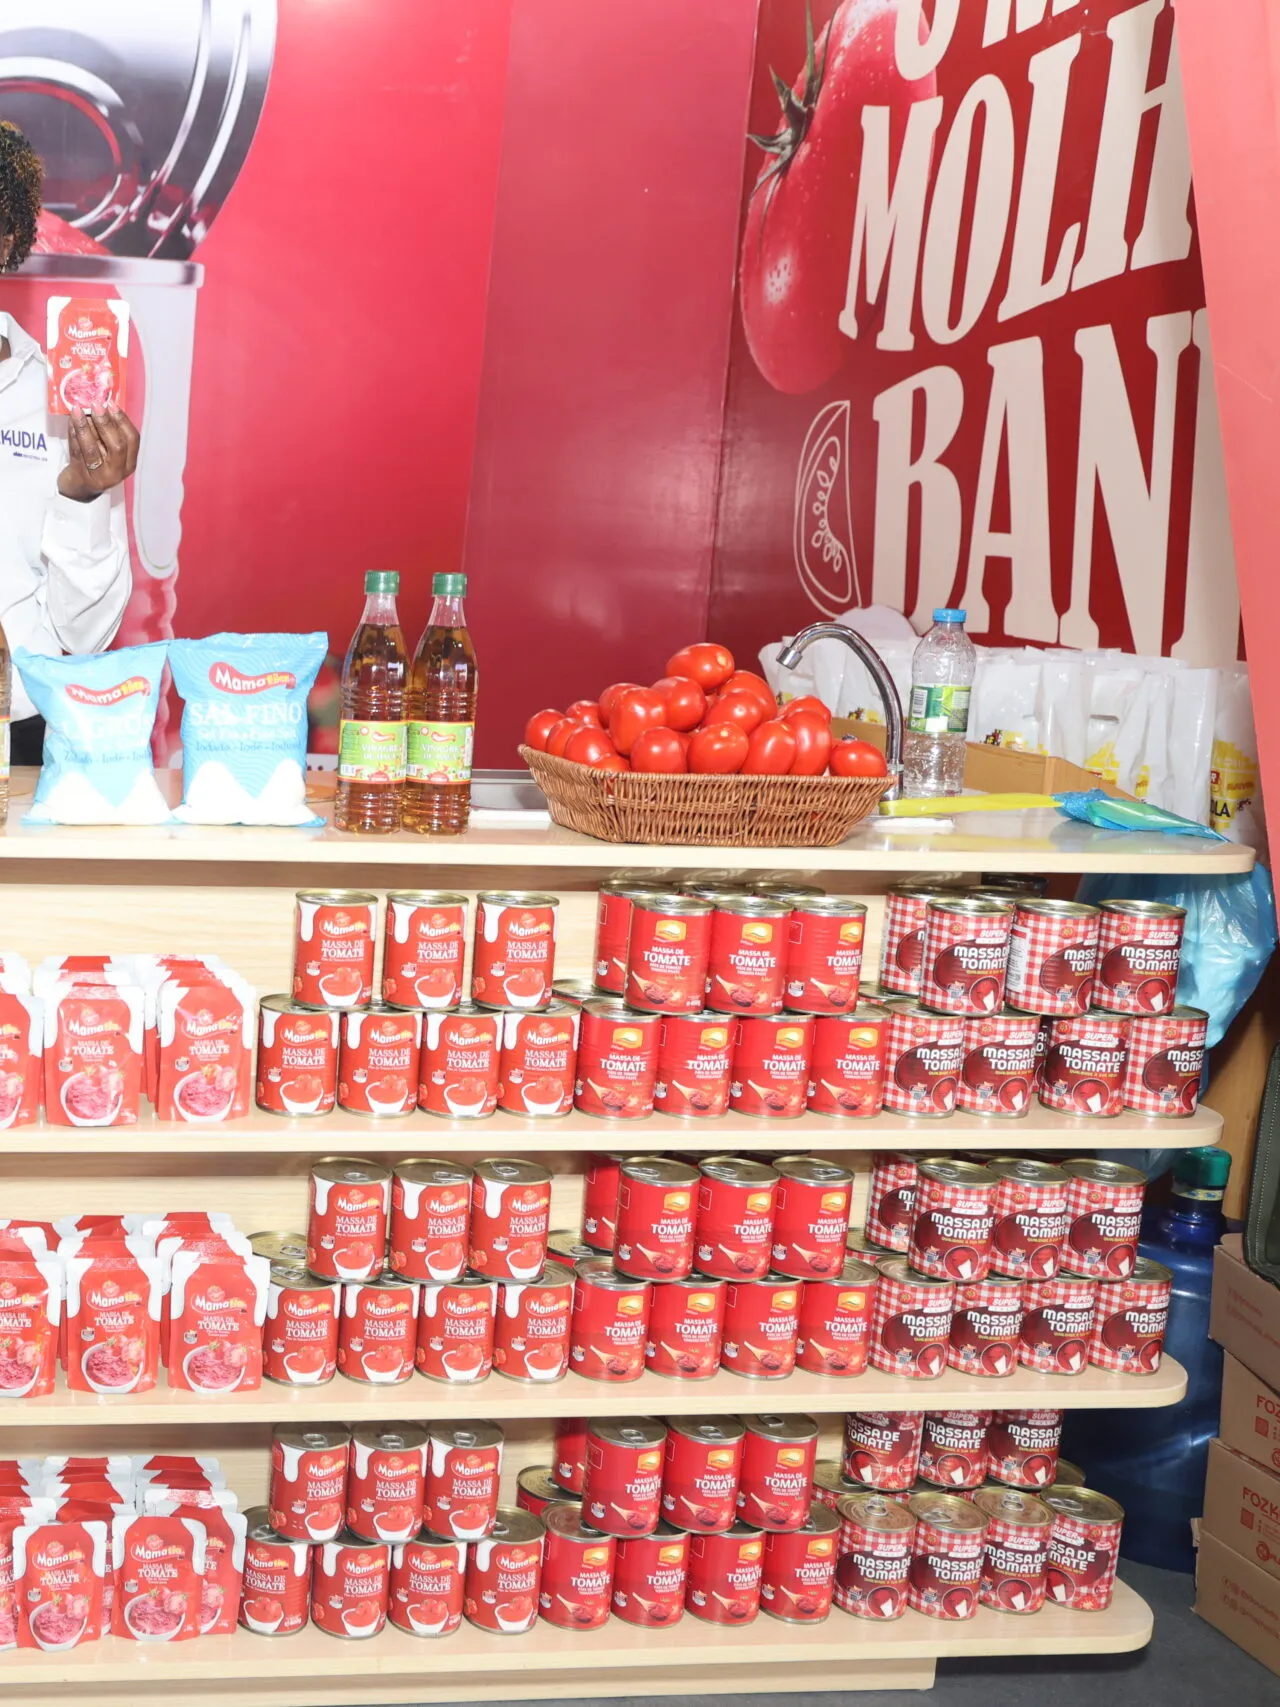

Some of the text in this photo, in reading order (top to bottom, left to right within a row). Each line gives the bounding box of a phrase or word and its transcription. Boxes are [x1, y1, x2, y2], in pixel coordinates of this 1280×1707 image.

[71, 346, 106, 355] TOMATE
[215, 667, 289, 691] Mamatia
[245, 703, 302, 724] FINO
[322, 940, 351, 949] MASSA
[508, 940, 536, 950] MASSA
[321, 948, 364, 958] TOMATE
[507, 949, 547, 959] TOMATE
[643, 951, 690, 966] TOMATE
[1121, 946, 1169, 959] MASSA
[1127, 958, 1178, 971] TOMATE
[72, 1045, 114, 1055] TOMATE
[189, 1045, 229, 1055] TOMATE
[283, 1047, 313, 1057] MASSA
[984, 1047, 1026, 1060] MASSA
[1060, 1045, 1125, 1062] MASSA DE
[282, 1056, 325, 1067] TOMATE
[601, 1059, 647, 1072] TOMATE
[989, 1058, 1034, 1071] TOMATE
[1064, 1058, 1120, 1072] TOMATE
[336, 1216, 365, 1226] MASSA
[931, 1213, 993, 1228] MASSA DE
[336, 1223, 376, 1233] TOMATE
[651, 1223, 692, 1235] TOMATE
[936, 1224, 989, 1239] TOMATE
[94, 1316, 134, 1326] TOMATE
[967, 1312, 1011, 1324] MASSA
[1043, 1309, 1086, 1322] MASSA
[198, 1320, 240, 1331] TOMATE
[286, 1320, 315, 1329] MASSA
[445, 1318, 474, 1328] MASSA
[825, 1321, 867, 1333] TOMATE
[973, 1323, 1019, 1335] TOMATE
[1049, 1321, 1094, 1333] TOMATE
[286, 1328, 328, 1338] TOMATE
[444, 1326, 485, 1337] TOMATE
[926, 1419, 986, 1439] MASSA DE
[930, 1434, 981, 1449] TOMATE
[376, 1480, 405, 1490] MASSA
[764, 1476, 807, 1489] TOMATE
[376, 1487, 416, 1498] TOMATE
[136, 1544, 183, 1558] Mamatia
[984, 1545, 1046, 1563] MASSA DE
[989, 1557, 1042, 1573] TOMATE
[138, 1568, 177, 1578] TOMATE
[246, 1568, 275, 1582] MASSA
[410, 1573, 438, 1583] MASSA
[40, 1574, 79, 1586] TOMATE
[245, 1577, 285, 1590] TOMATE
[409, 1581, 450, 1591] TOMATE
[571, 1575, 610, 1588] TOMATE
